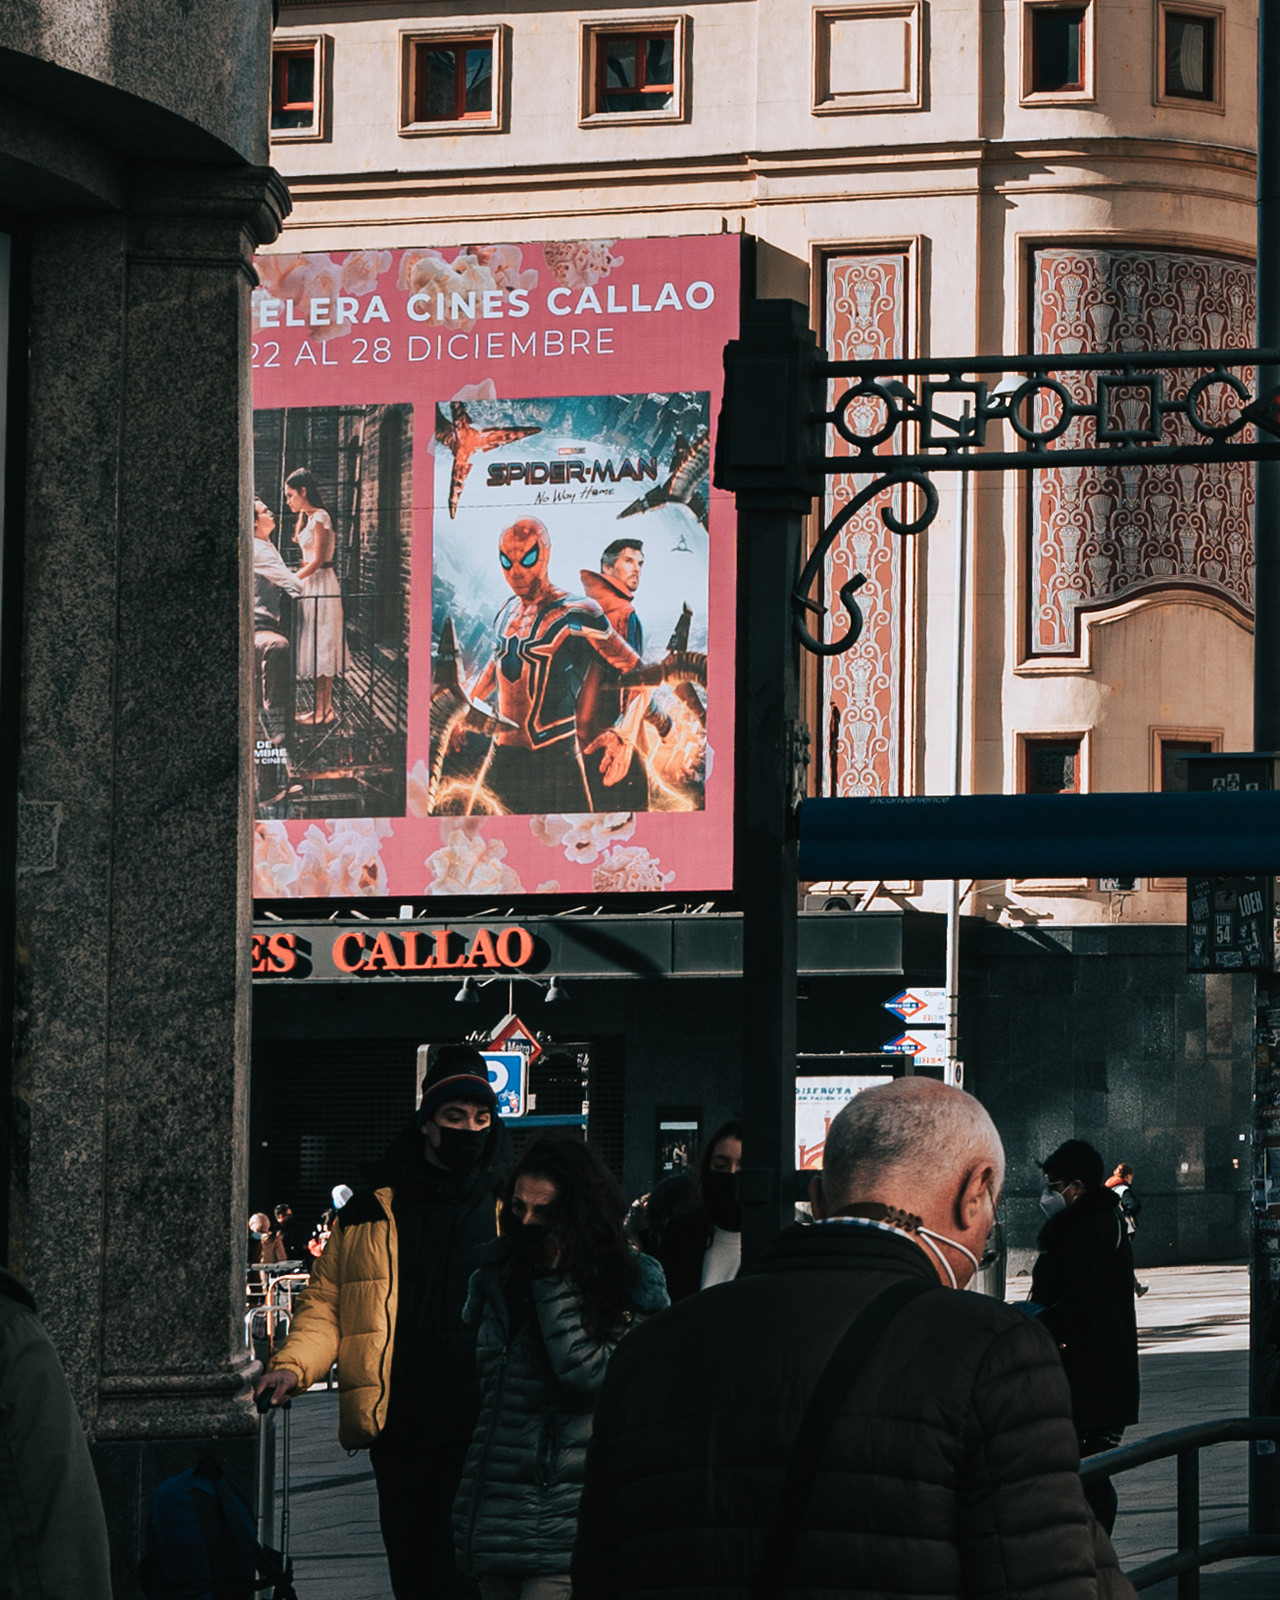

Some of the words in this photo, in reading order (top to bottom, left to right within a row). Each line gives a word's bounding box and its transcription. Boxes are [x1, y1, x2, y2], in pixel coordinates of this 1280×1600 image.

[406, 288, 530, 322] CINES
[547, 281, 715, 315] CALLAO
[294, 339, 338, 366] AL
[351, 336, 392, 364] 28
[408, 328, 615, 362] DICIEMBRE
[333, 927, 534, 972] CALLAO
[1216, 925, 1231, 944] 54
